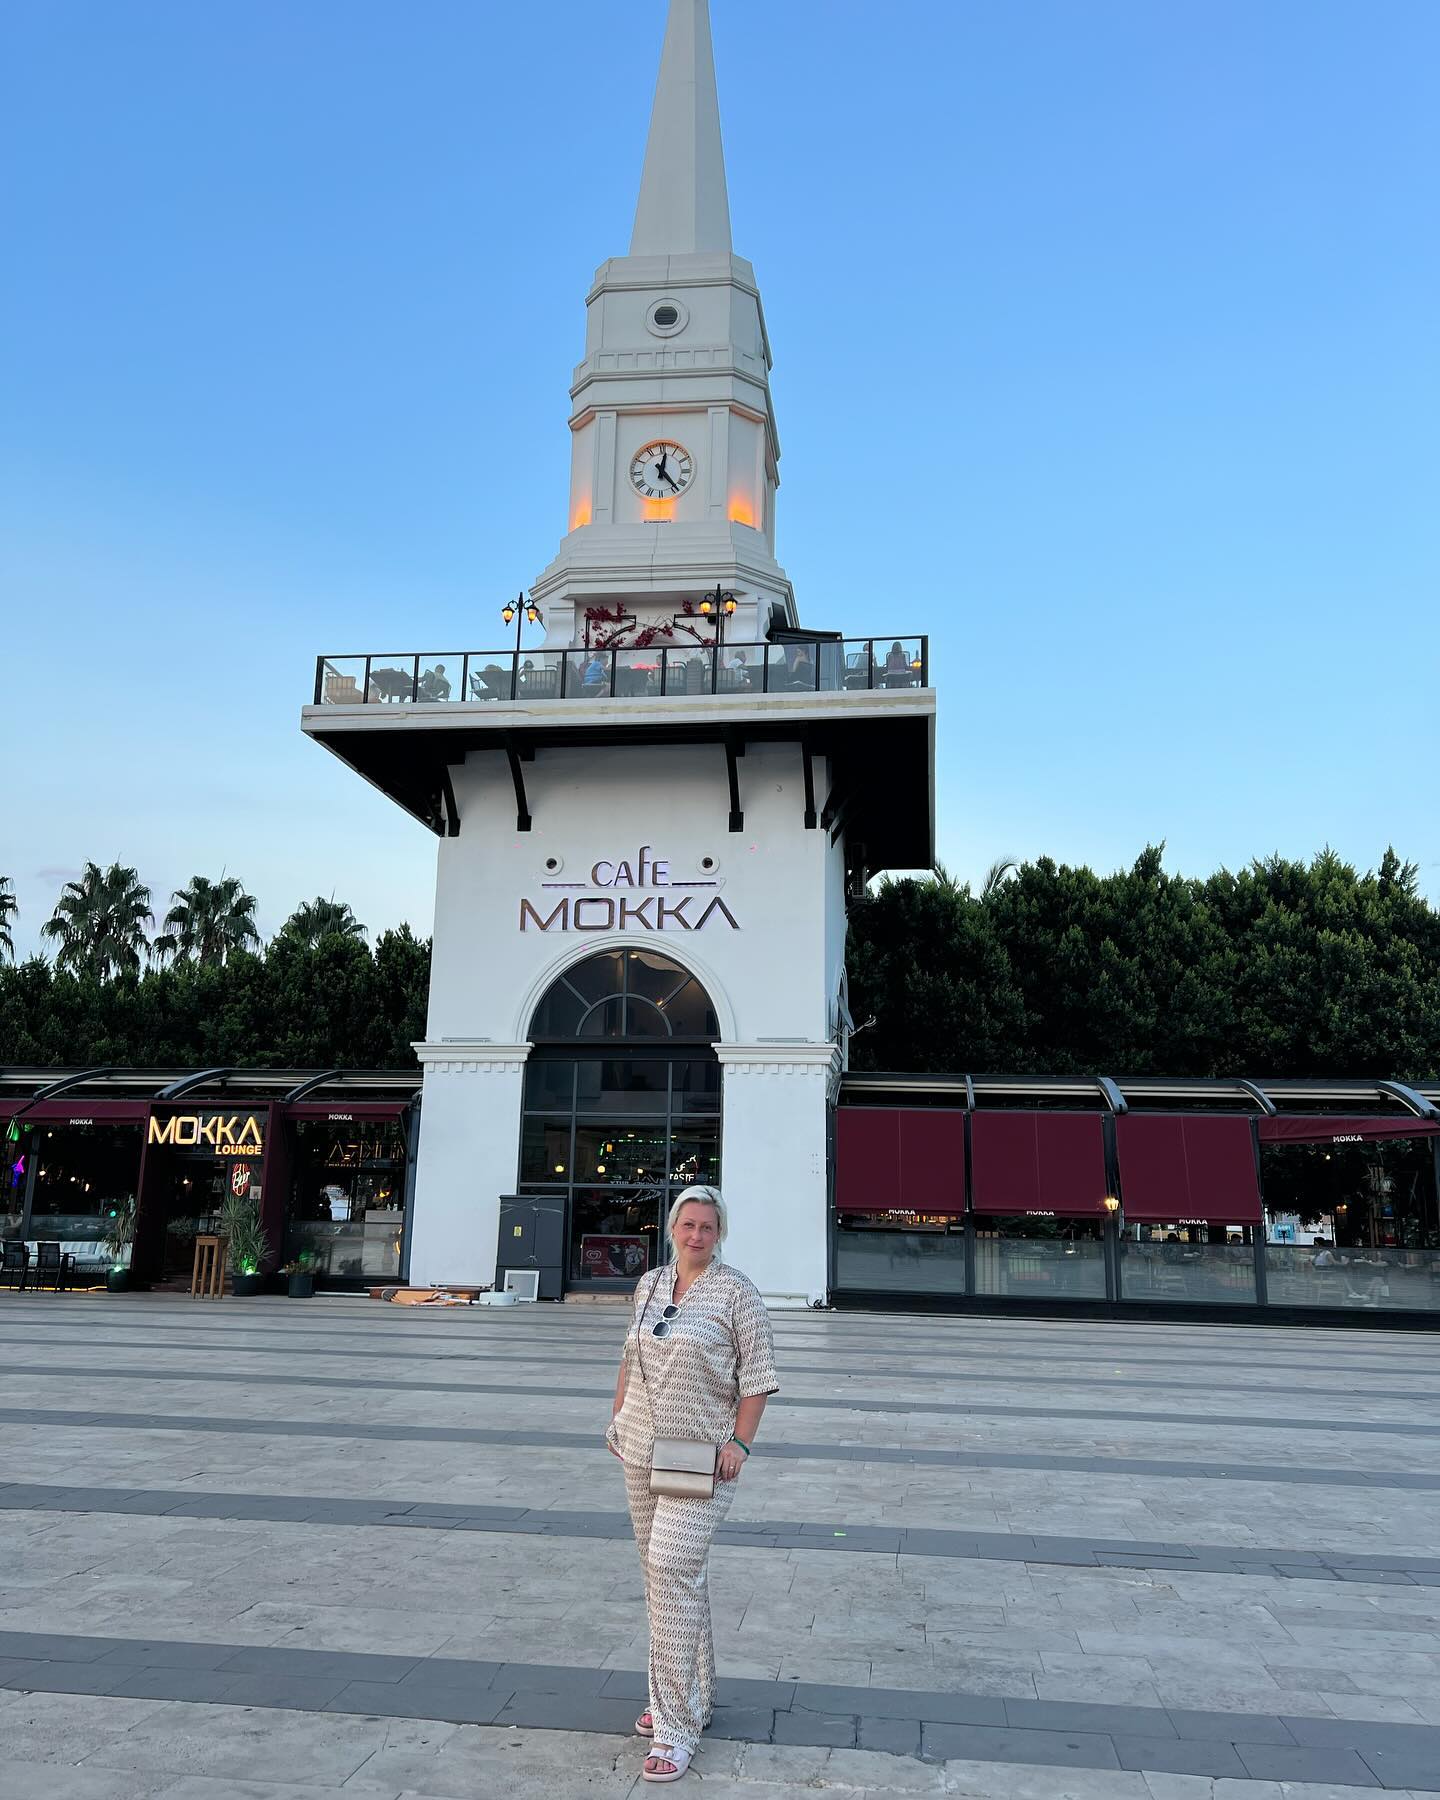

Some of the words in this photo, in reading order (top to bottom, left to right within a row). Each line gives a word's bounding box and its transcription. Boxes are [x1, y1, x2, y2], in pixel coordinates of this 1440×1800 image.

[519, 896, 740, 931] MOKKA
[328, 1113, 353, 1121] MOKKA
[148, 1115, 263, 1145] MOKKA
[1332, 1134, 1364, 1143] MOKKA
[215, 1145, 262, 1155] LOUNGE
